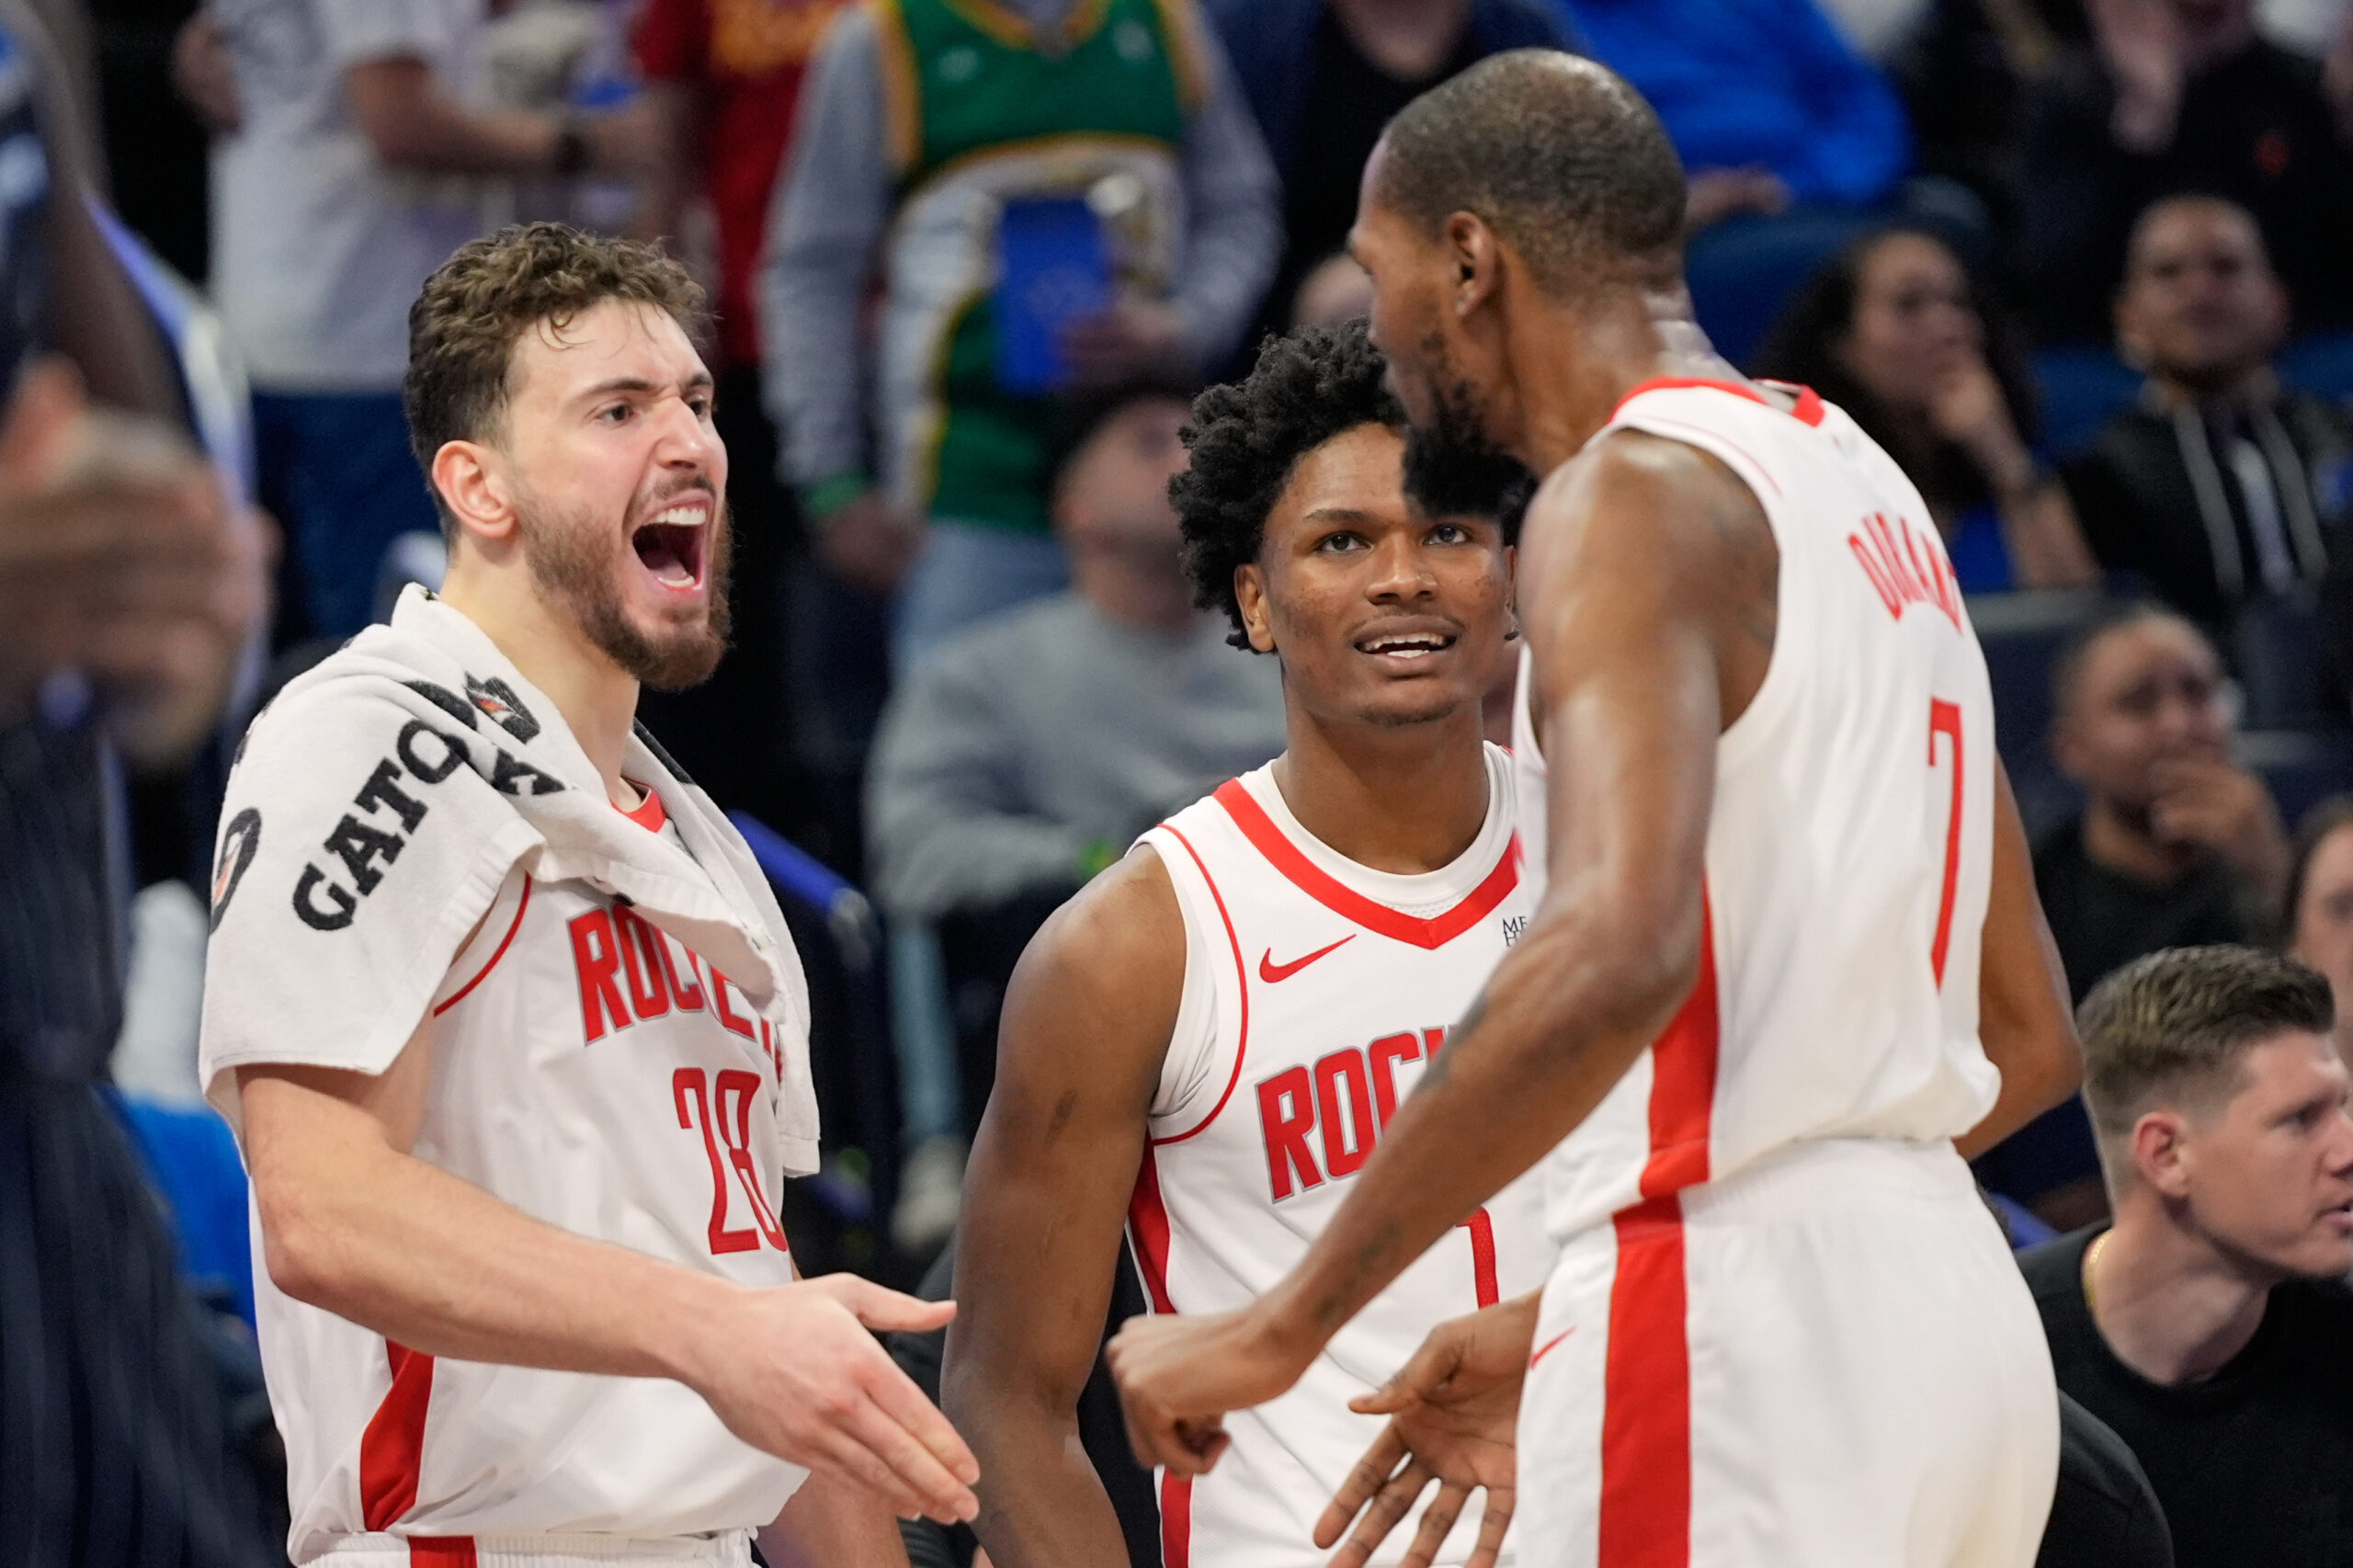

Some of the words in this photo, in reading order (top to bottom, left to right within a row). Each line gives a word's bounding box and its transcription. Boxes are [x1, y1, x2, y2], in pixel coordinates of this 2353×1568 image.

[1927, 695, 1963, 994] 7
[672, 1067, 788, 1256] 28
[1255, 1025, 1461, 1204] ROC
